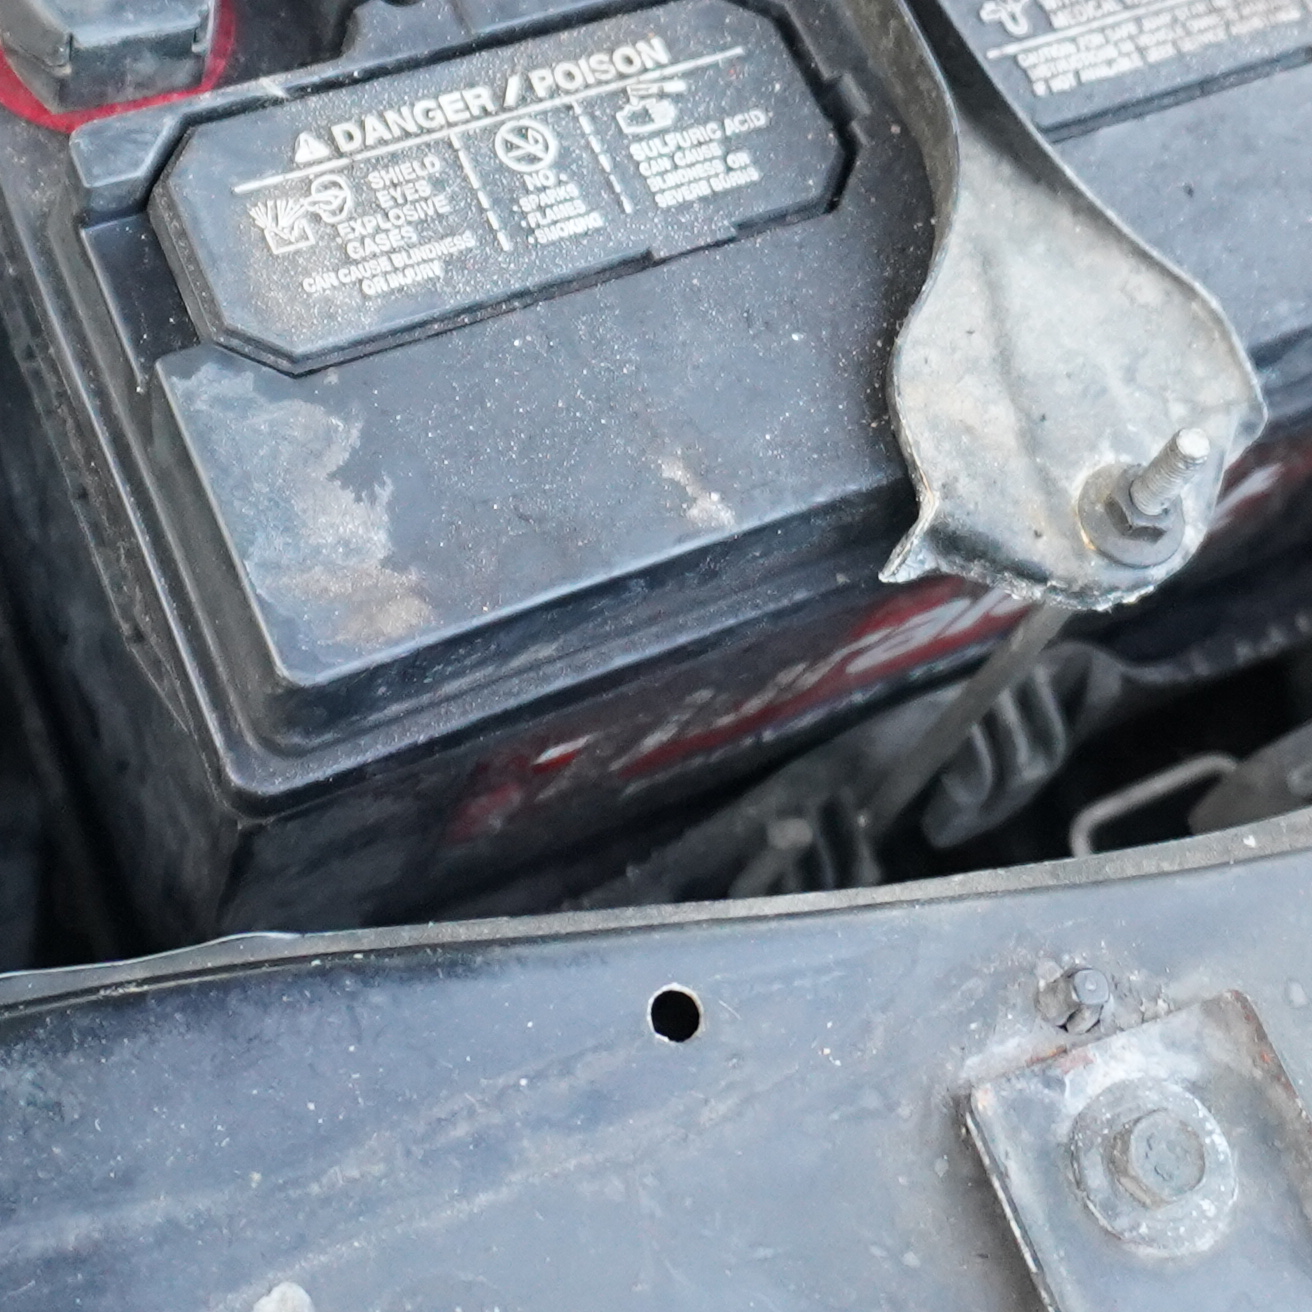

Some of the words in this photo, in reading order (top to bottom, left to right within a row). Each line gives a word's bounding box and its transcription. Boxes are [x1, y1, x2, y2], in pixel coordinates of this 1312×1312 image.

[332, 88, 494, 154] DANGER
[531, 36, 673, 98] POISON
[630, 122, 721, 159] SULFURIC
[722, 110, 766, 134] ACID
[368, 157, 441, 187] SHIELD
[639, 157, 670, 175] CAN
[673, 143, 720, 165] CAUSE
[648, 161, 725, 191] BLINDNESS
[726, 153, 749, 169] OR
[377, 181, 431, 206] EYES
[655, 181, 710, 207] SEVERE
[710, 168, 759, 191] BURNS
[337, 197, 451, 238] EXPLOSIVE
[345, 228, 417, 258] GASES
[301, 271, 337, 292] CAN
[336, 257, 391, 282] CAUSE
[391, 233, 475, 266] BLINDNESS
[361, 276, 387, 294] OR
[387, 262, 442, 287] INJURY
